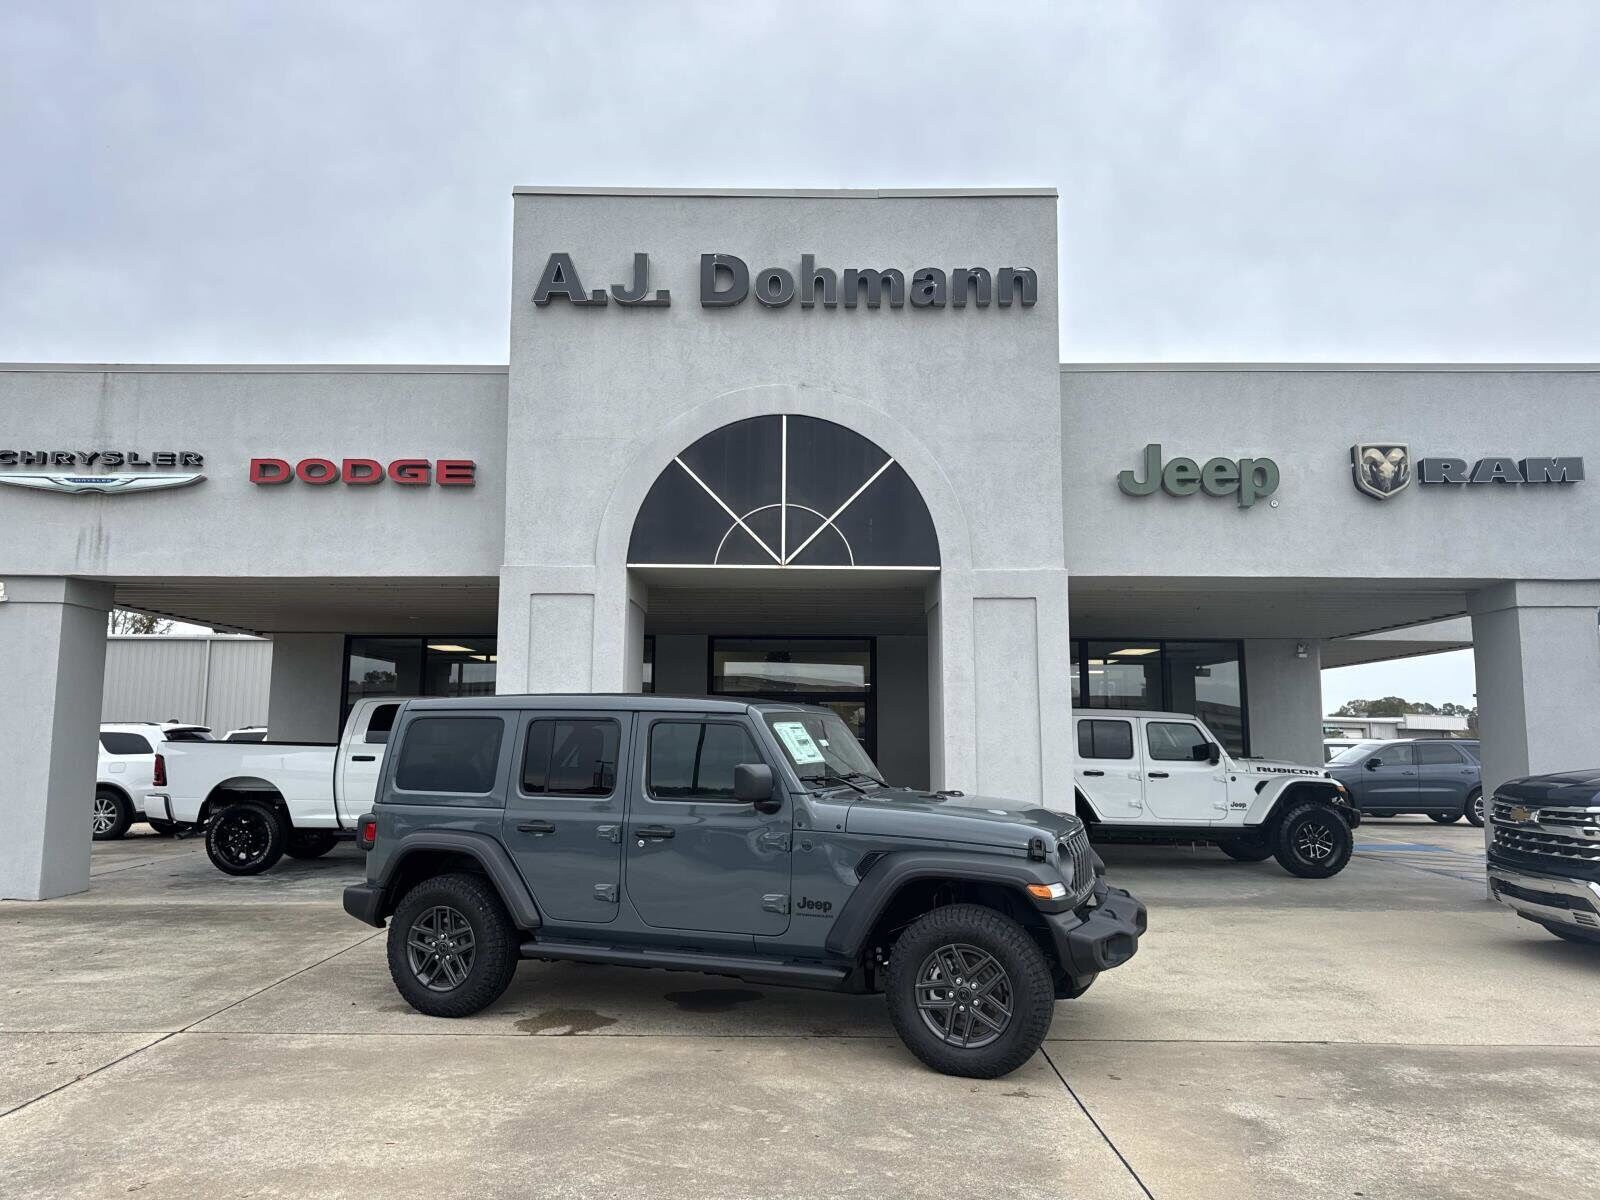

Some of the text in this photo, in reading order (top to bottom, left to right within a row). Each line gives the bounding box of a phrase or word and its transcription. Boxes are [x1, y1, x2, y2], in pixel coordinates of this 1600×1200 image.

[532, 252, 1038, 308] A.J. Dohmann
[249, 458, 477, 486] DODGE
[1418, 456, 1585, 487] RAM
[1256, 766, 1319, 776] RUBICON
[1230, 801, 1247, 809] Jeep
[797, 896, 832, 912] Jeep
